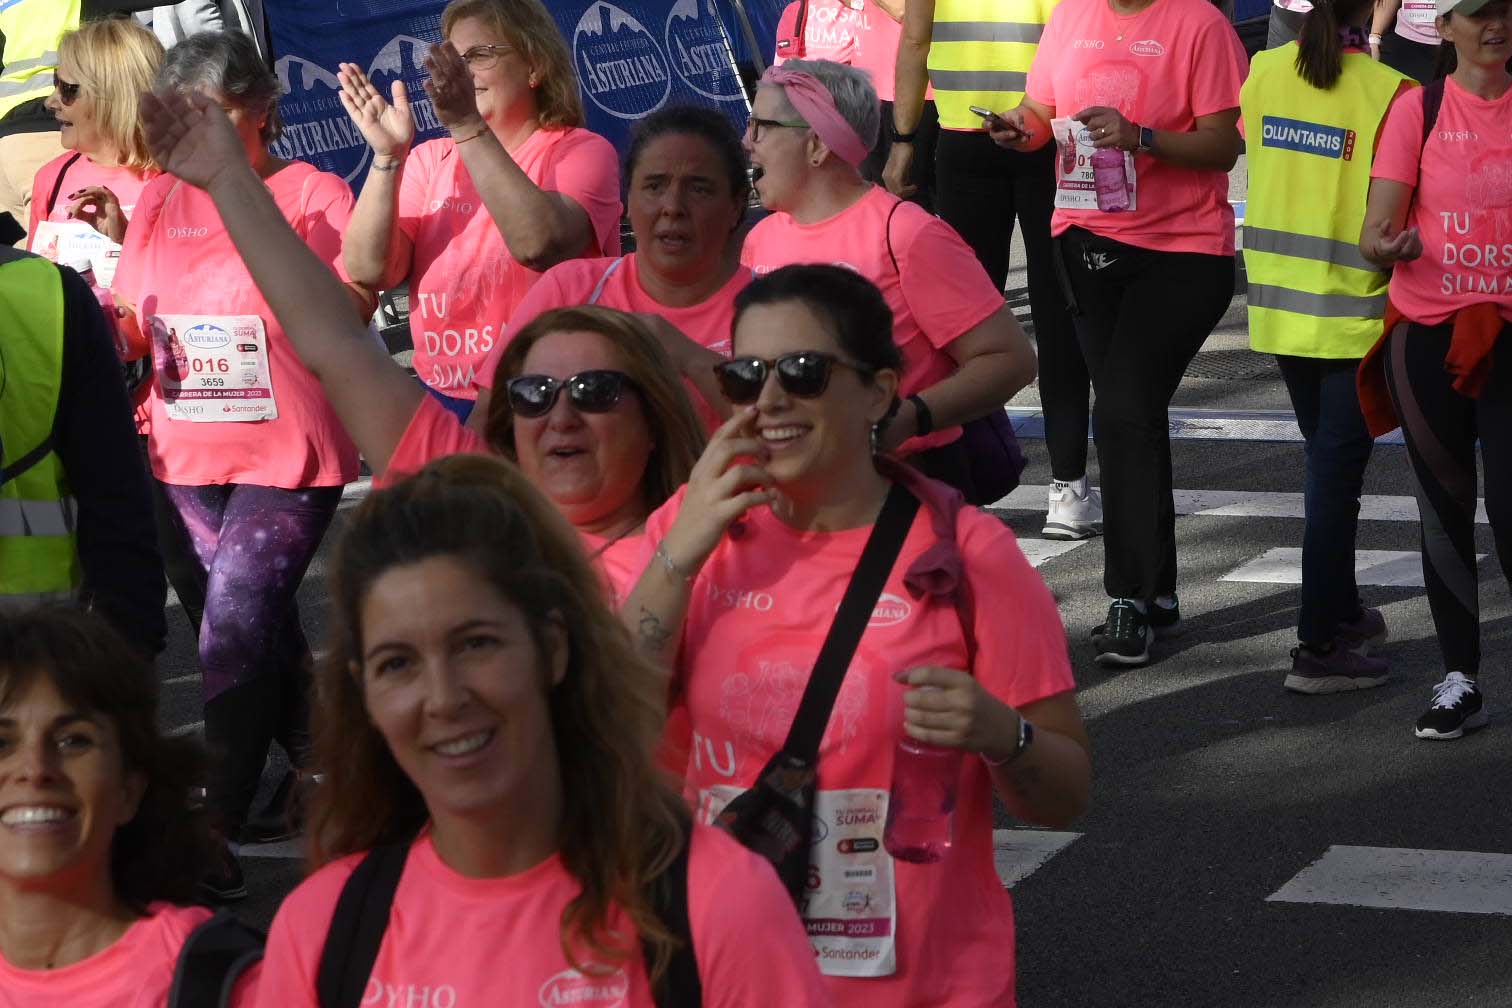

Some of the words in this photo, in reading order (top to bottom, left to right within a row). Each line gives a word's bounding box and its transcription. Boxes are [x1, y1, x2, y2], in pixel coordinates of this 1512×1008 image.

[585, 50, 668, 95] ASTURIANA
[1438, 130, 1478, 142] OYSHO
[1439, 210, 1470, 235] TU
[167, 227, 208, 239] OYSHO
[418, 292, 447, 319] TU
[188, 333, 228, 343] ASTURIANA
[192, 358, 230, 373] 016
[200, 378, 224, 387] 3659
[836, 815, 876, 826] SUMA
[807, 923, 845, 932] MUJER
[847, 922, 875, 933] 2023
[822, 946, 880, 961] Santander
